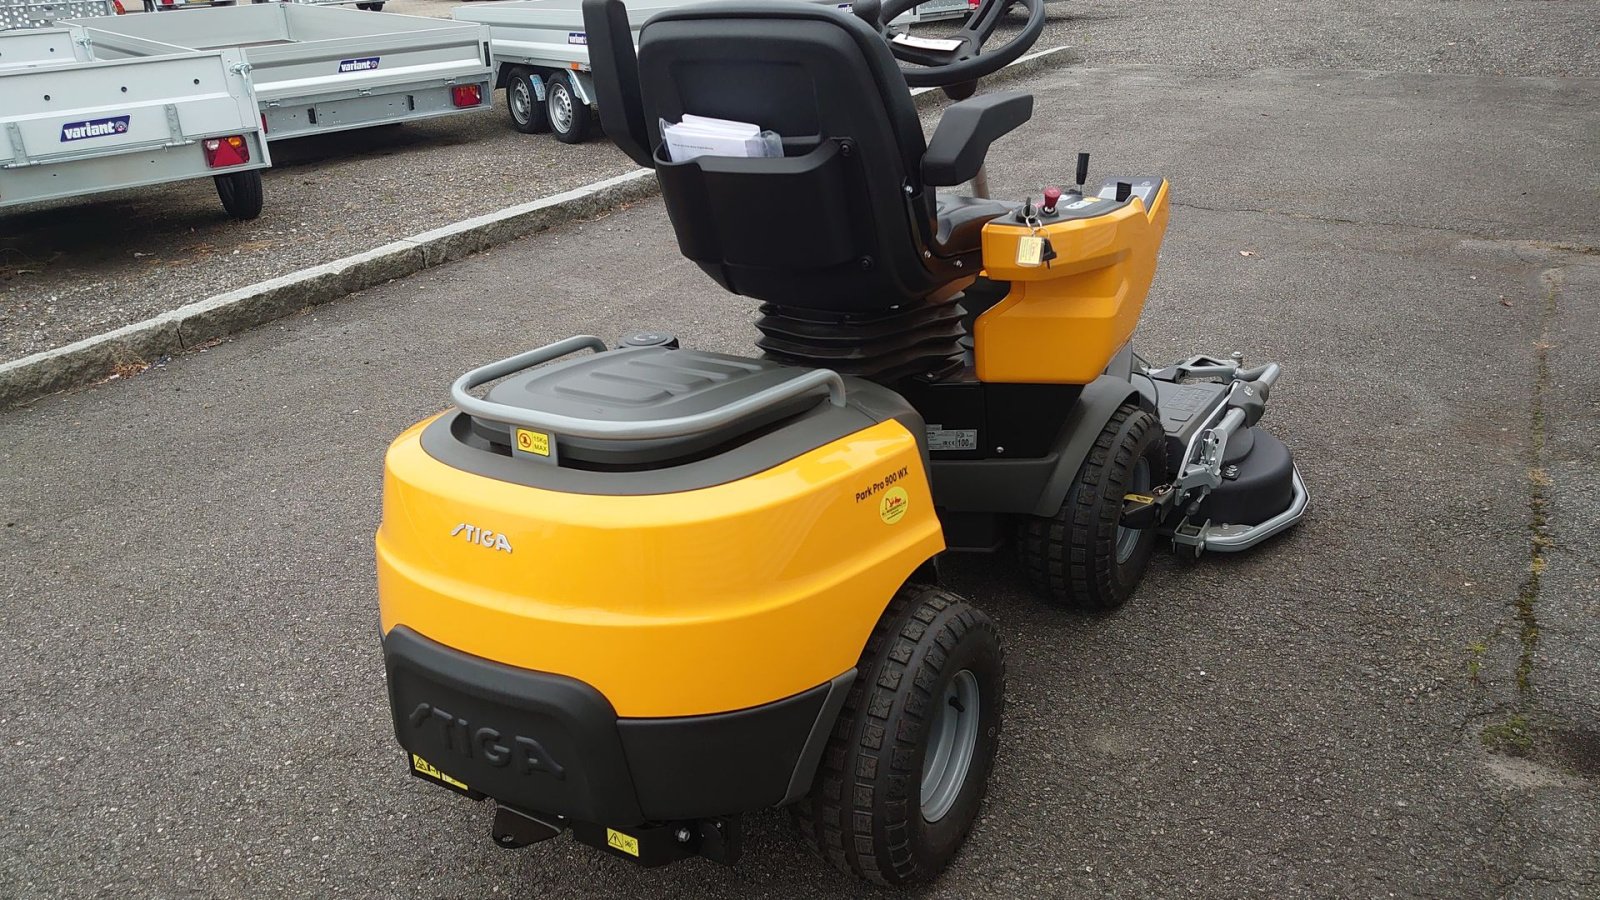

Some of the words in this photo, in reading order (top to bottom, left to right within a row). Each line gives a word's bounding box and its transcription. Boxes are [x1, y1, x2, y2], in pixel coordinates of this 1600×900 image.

[341, 60, 370, 72] variant
[64, 121, 115, 139] variant
[534, 443, 548, 452] MAX
[958, 438, 969, 447] 100
[855, 486, 872, 503] Park
[873, 481, 884, 494] Pro
[884, 472, 897, 486] 900
[897, 465, 909, 480] WX
[450, 523, 513, 554] STIGA
[408, 702, 567, 781] STIGA
